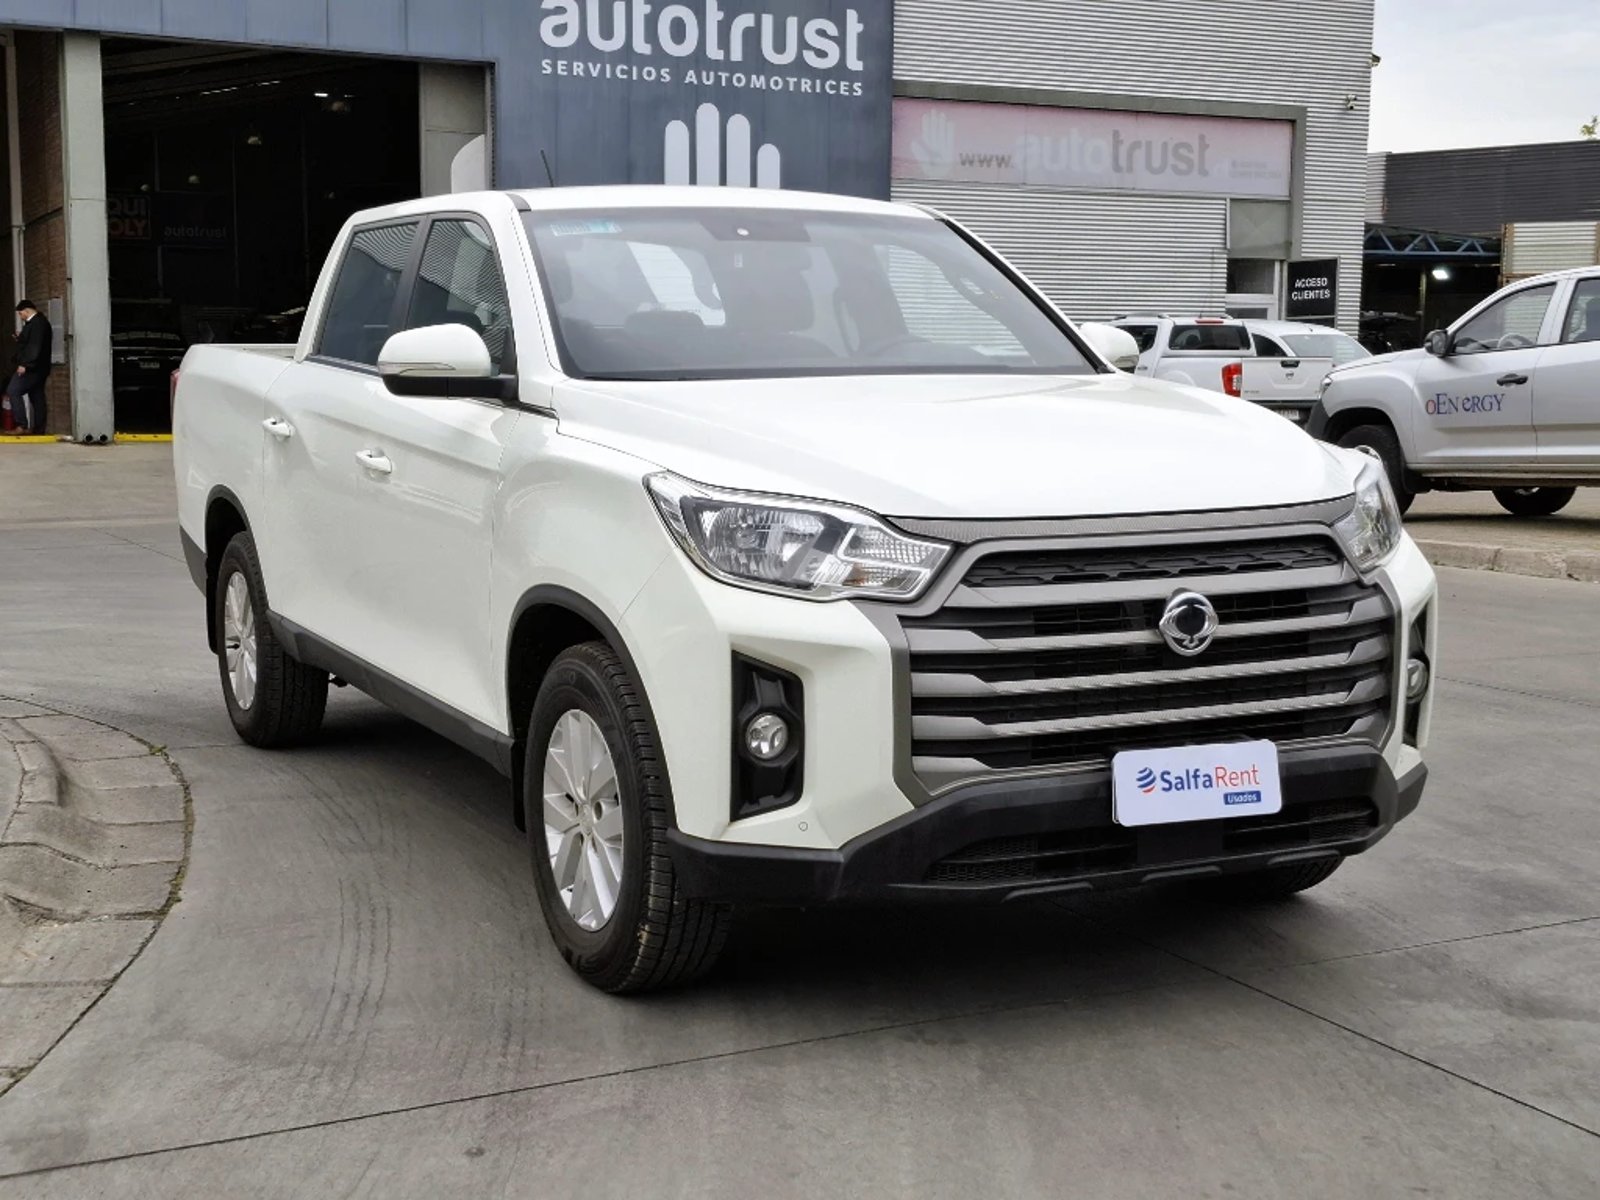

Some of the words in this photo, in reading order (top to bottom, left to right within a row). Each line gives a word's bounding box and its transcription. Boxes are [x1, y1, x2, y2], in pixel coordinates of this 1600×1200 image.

[540, 0, 864, 71] autotrust
[541, 59, 671, 83] SERVICIOS
[684, 69, 863, 96] AUTOMOTRICES
[164, 224, 227, 238] autotrust
[1294, 276, 1328, 289] ACCESO
[1291, 288, 1331, 301] CLIENTES
[1160, 764, 1260, 792] SalfaRent
[1227, 792, 1258, 804] Usados
